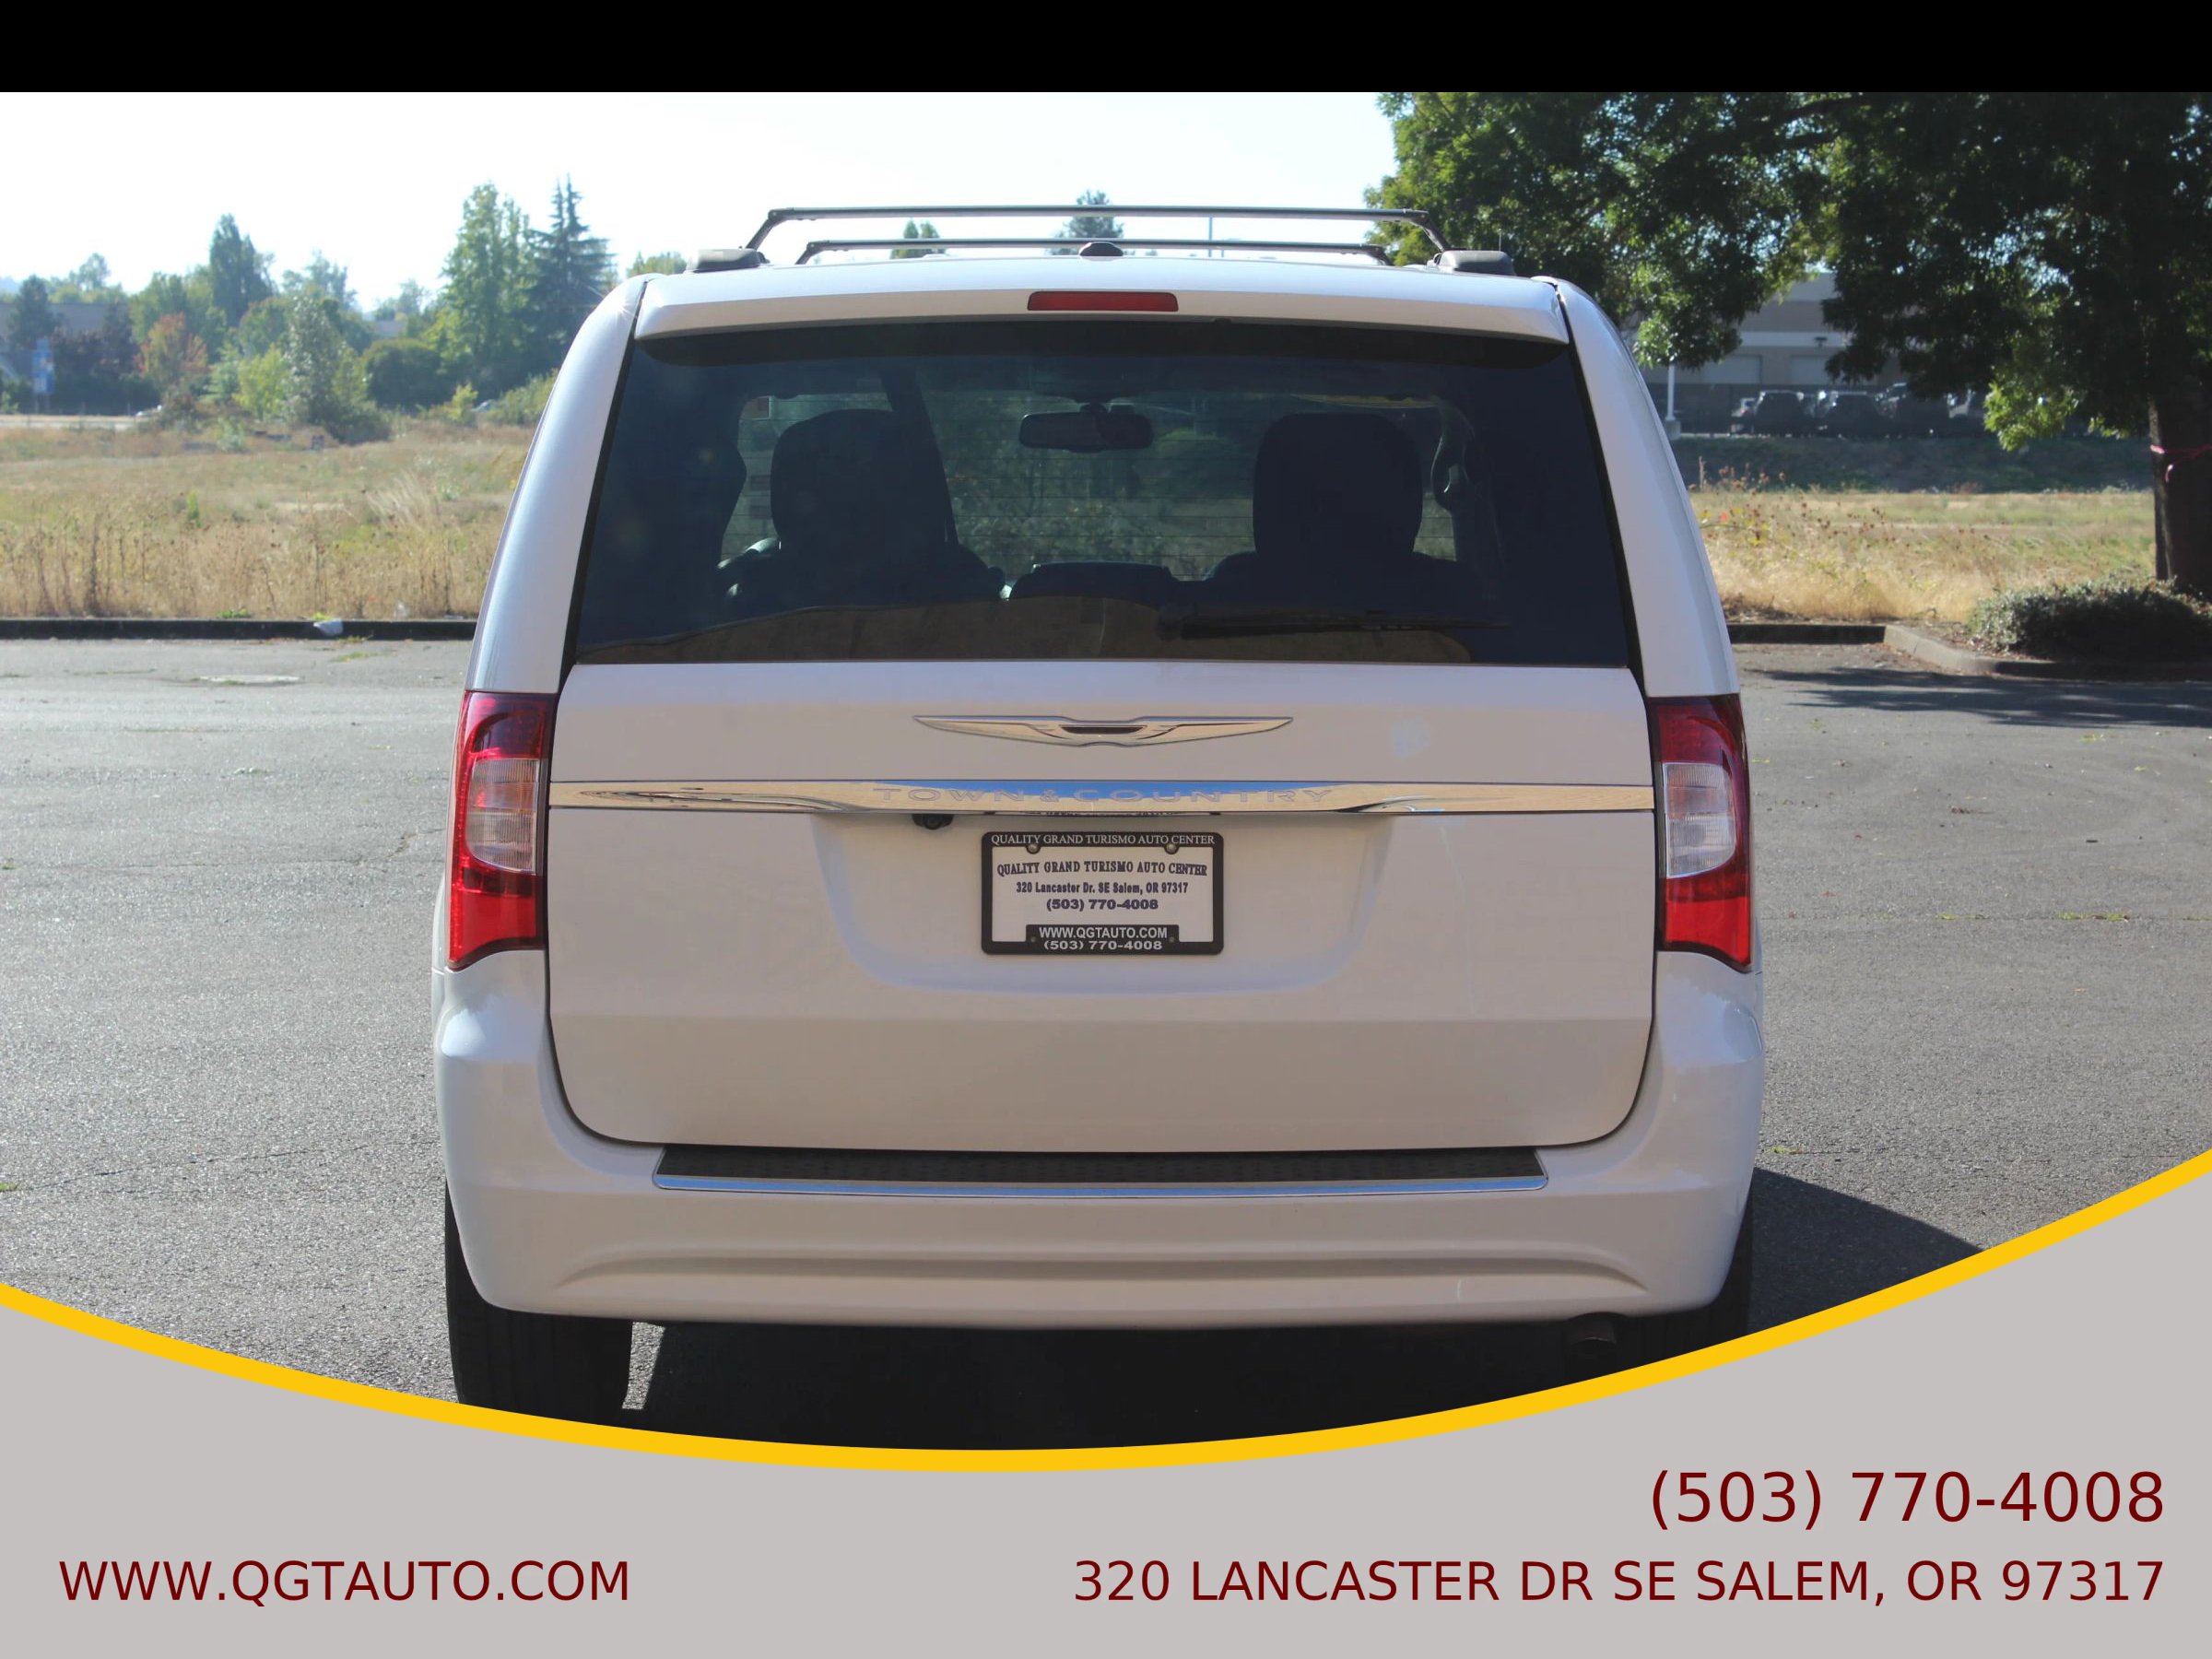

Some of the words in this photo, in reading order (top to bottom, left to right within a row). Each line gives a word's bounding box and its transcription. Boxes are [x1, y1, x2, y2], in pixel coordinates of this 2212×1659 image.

[991, 834, 1041, 845] QUALITY
[1042, 834, 1083, 844] GRAND
[1086, 834, 1135, 844] TURISMO
[1138, 834, 1169, 844] AUTO
[1171, 834, 1216, 844] CENTER
[996, 863, 1041, 877] QUALITY
[1043, 861, 1081, 874] GRAND
[1084, 861, 1134, 873] TURISMO
[1136, 861, 1166, 874] AUTO
[1168, 863, 1208, 877] CENTER
[1016, 882, 1033, 893] 320
[1035, 882, 1080, 894] Lancaster
[1083, 882, 1096, 894] Dr.
[1098, 882, 1111, 894] SE
[1112, 882, 1144, 895] Salem,
[1146, 882, 1159, 894] OR
[1161, 882, 1189, 894] 97317
[1046, 899, 1085, 912] (503)
[1088, 899, 1159, 911] 770-4008
[1039, 926, 1168, 939] WWW.QGTAUTO.COM
[1043, 940, 1084, 951] (503)
[1088, 940, 1163, 950] 770-4008
